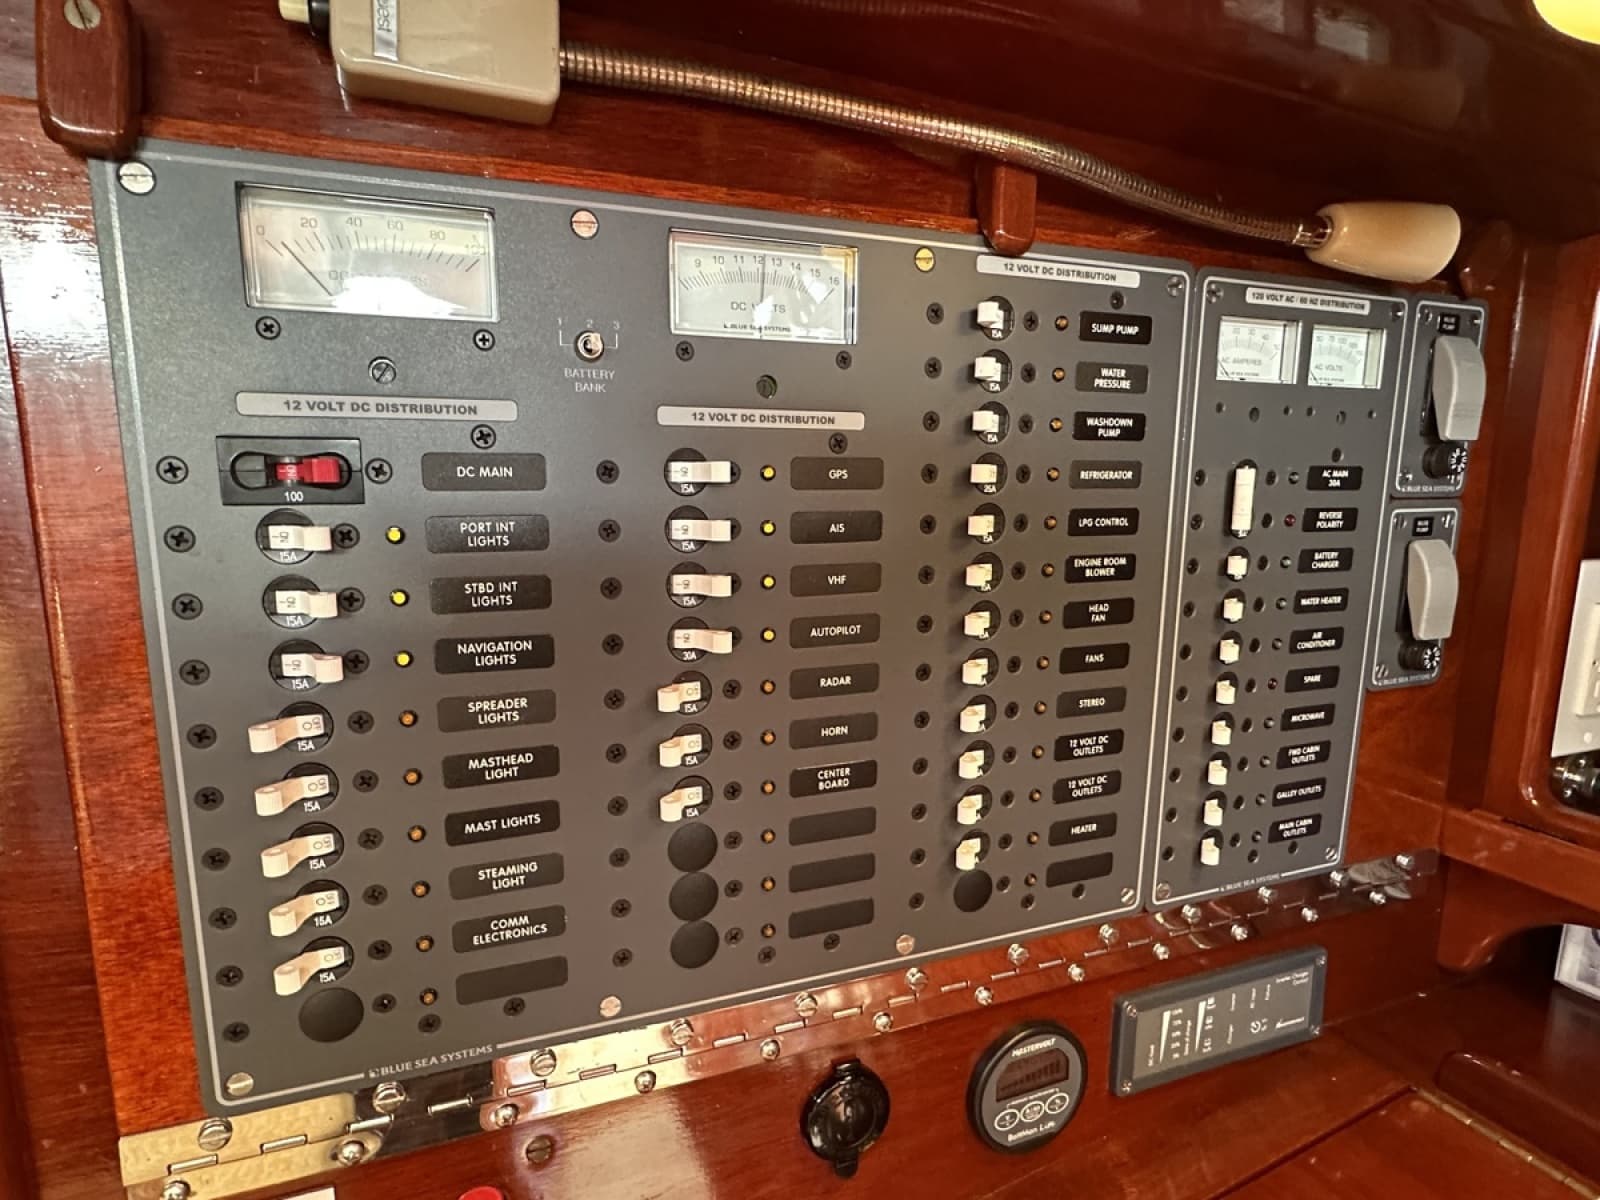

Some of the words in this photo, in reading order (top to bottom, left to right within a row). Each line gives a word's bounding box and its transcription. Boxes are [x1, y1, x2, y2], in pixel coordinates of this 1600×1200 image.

[300, 217, 317, 228] 20
[346, 216, 362, 228] 40
[387, 220, 404, 231] 60
[429, 230, 446, 240] 80
[694, 258, 702, 268] 9
[712, 256, 724, 264] 10
[734, 255, 744, 264] 11
[752, 255, 764, 264] 12
[772, 258, 782, 267] 13
[791, 262, 801, 271] 14
[1004, 262, 1014, 272] 12
[1016, 264, 1040, 274] VOLT
[1042, 266, 1054, 276] DC
[1056, 268, 1117, 282] DISTRIBUTION
[810, 268, 821, 278] 15
[829, 276, 840, 286] 16
[1266, 293, 1284, 302] VOLT
[1286, 295, 1295, 304] AC
[730, 301, 746, 311] DC
[1091, 323, 1114, 334] SUMP
[1116, 324, 1140, 336] PUMP
[564, 367, 616, 381] BATTERY
[1100, 367, 1126, 378] WATER
[574, 382, 606, 393] BANK
[1094, 378, 1131, 390] PRESSURE
[283, 400, 302, 410] 12
[308, 401, 345, 412] VOLT
[350, 402, 371, 413] DC
[376, 403, 478, 415] DISTRIBUTION
[691, 412, 704, 422] 12
[708, 413, 738, 422] VOLT
[740, 414, 756, 423] DC
[759, 414, 836, 426] DISTRIBUTION
[1086, 418, 1133, 428] WASHDOWN
[1098, 428, 1120, 438] PUMP
[456, 466, 476, 478] DC
[478, 466, 513, 478] MAIN
[828, 469, 848, 480] GPS
[1080, 470, 1133, 480] REFRIGERATOR
[284, 491, 304, 502] 100
[460, 522, 492, 534] PORT
[496, 522, 516, 533] INT
[1078, 518, 1094, 528] LPG
[1095, 517, 1129, 528] CONTROL
[1316, 520, 1344, 530] POLARITY
[829, 523, 846, 534] AIS
[468, 536, 510, 547] LIGHTS
[280, 551, 298, 562] 15A
[1074, 558, 1102, 568] ENGINE
[1104, 557, 1127, 566] ROOM
[1085, 568, 1116, 578] BLOWER
[827, 575, 847, 586] VHF
[464, 582, 495, 594] STBD
[498, 582, 518, 592] INT
[471, 595, 513, 608] LIGHTS
[1088, 604, 1110, 613] HEAD
[286, 616, 304, 626] 15A
[1091, 614, 1106, 623] FAN
[810, 624, 862, 638] AUTOPILOT
[457, 640, 533, 654] NAVIGATION
[475, 654, 517, 667] LIGHTS
[1085, 654, 1104, 664] FANS
[292, 679, 309, 690] 15A
[820, 676, 852, 688] RADAR
[468, 697, 528, 713] SPREADER
[684, 704, 698, 712] 15A
[1078, 697, 1106, 708] STEREO
[478, 711, 520, 724] LIGHTS
[820, 726, 849, 737] HORN
[297, 740, 316, 752] 15A
[1069, 740, 1078, 748] 12
[1079, 738, 1096, 748] VOLT
[1098, 736, 1109, 744] DC
[1072, 745, 1104, 757] OUTLETS
[468, 752, 534, 770] MASTHEAD
[684, 756, 698, 765] 15A
[484, 766, 519, 781] LIGHT
[817, 768, 851, 780] CENTER
[818, 778, 850, 791] BOARD
[1068, 780, 1076, 788] 12
[1078, 778, 1096, 788] VOLT
[1096, 775, 1108, 784] DC
[1072, 786, 1103, 798] OUTLETS
[303, 801, 321, 812] 15A
[686, 808, 700, 817] 15A
[464, 820, 497, 834] MAST
[500, 814, 542, 830] LIGHTS
[1070, 823, 1097, 836] HEATER
[309, 858, 326, 870] 15A
[478, 862, 538, 881] STEAMING
[492, 875, 526, 890] LIGHT
[314, 914, 332, 928] 15A
[490, 915, 530, 930] COMM
[472, 924, 548, 946] ELECTRONICS
[320, 972, 336, 984] 15A
[380, 1060, 413, 1076] BLUE
[414, 1054, 439, 1070] SEA
[440, 1044, 493, 1064] SYSTEMS
